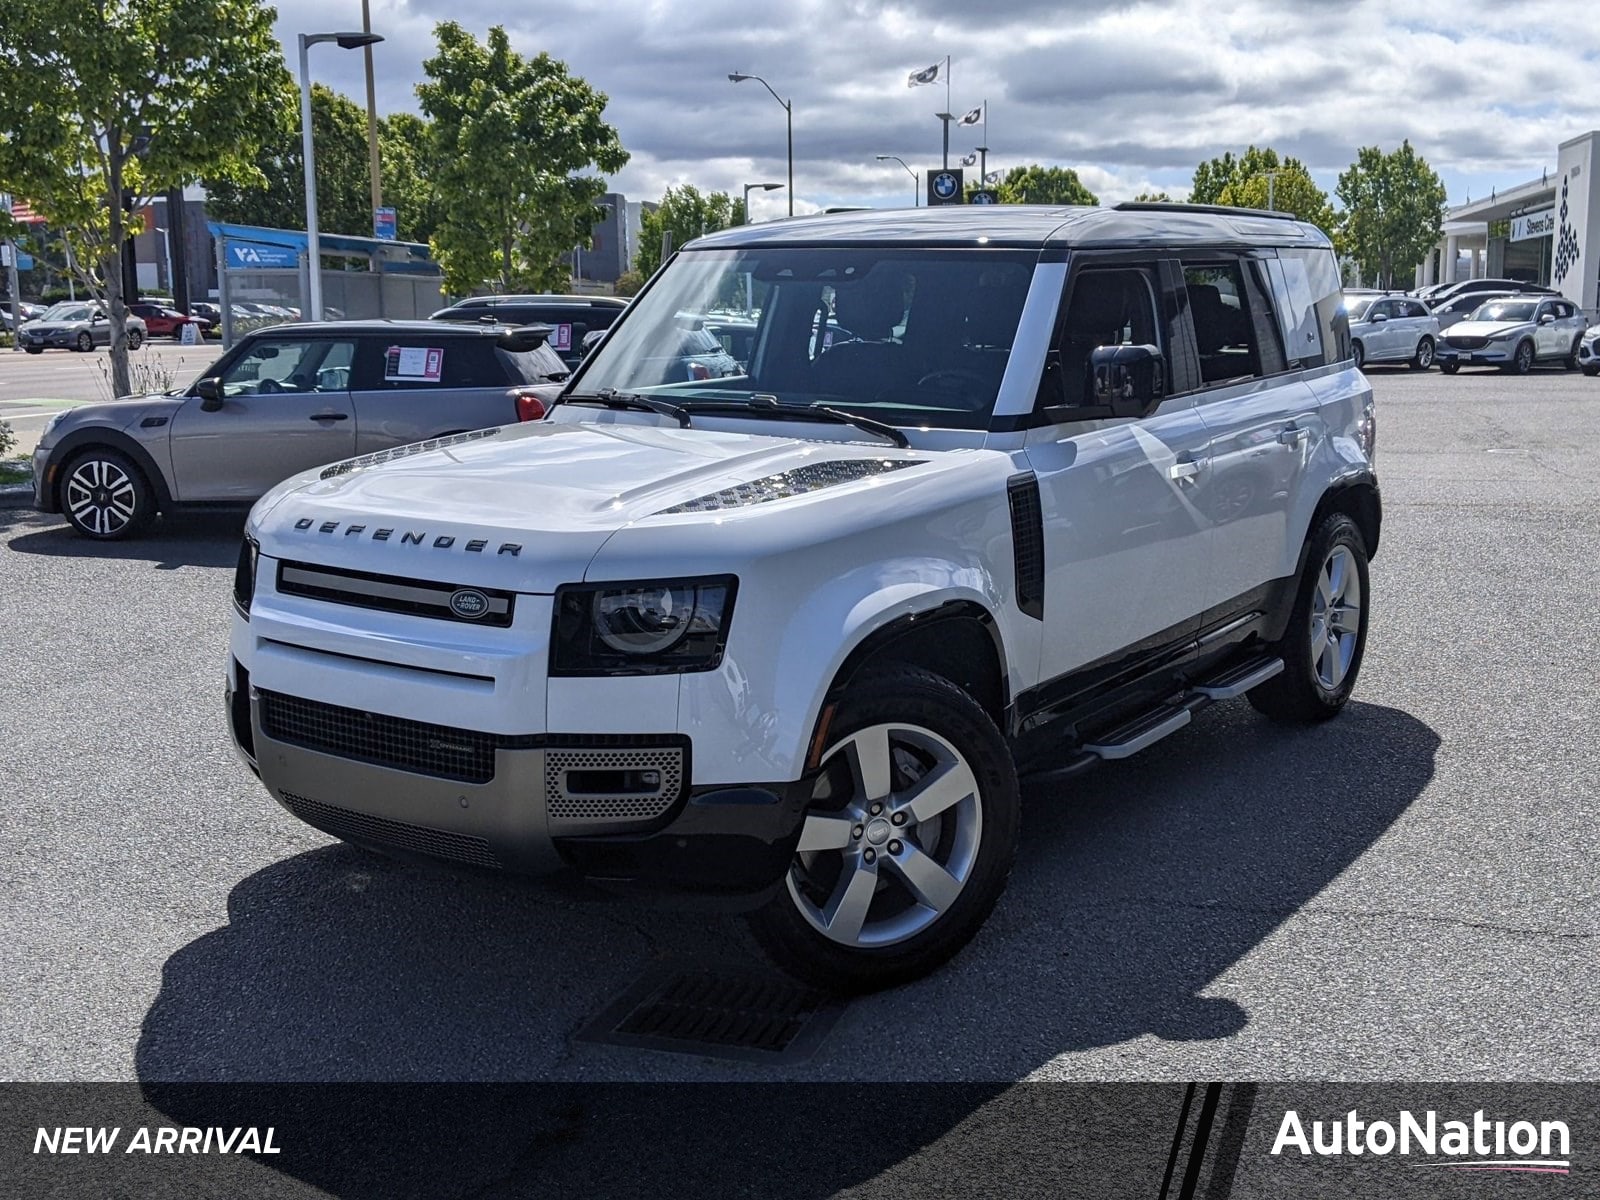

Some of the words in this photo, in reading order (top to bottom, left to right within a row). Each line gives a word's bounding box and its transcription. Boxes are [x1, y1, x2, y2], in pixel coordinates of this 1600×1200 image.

[294, 518, 523, 556] DEFENDER
[460, 595, 476, 603] LAND
[460, 602, 481, 610] ROVER
